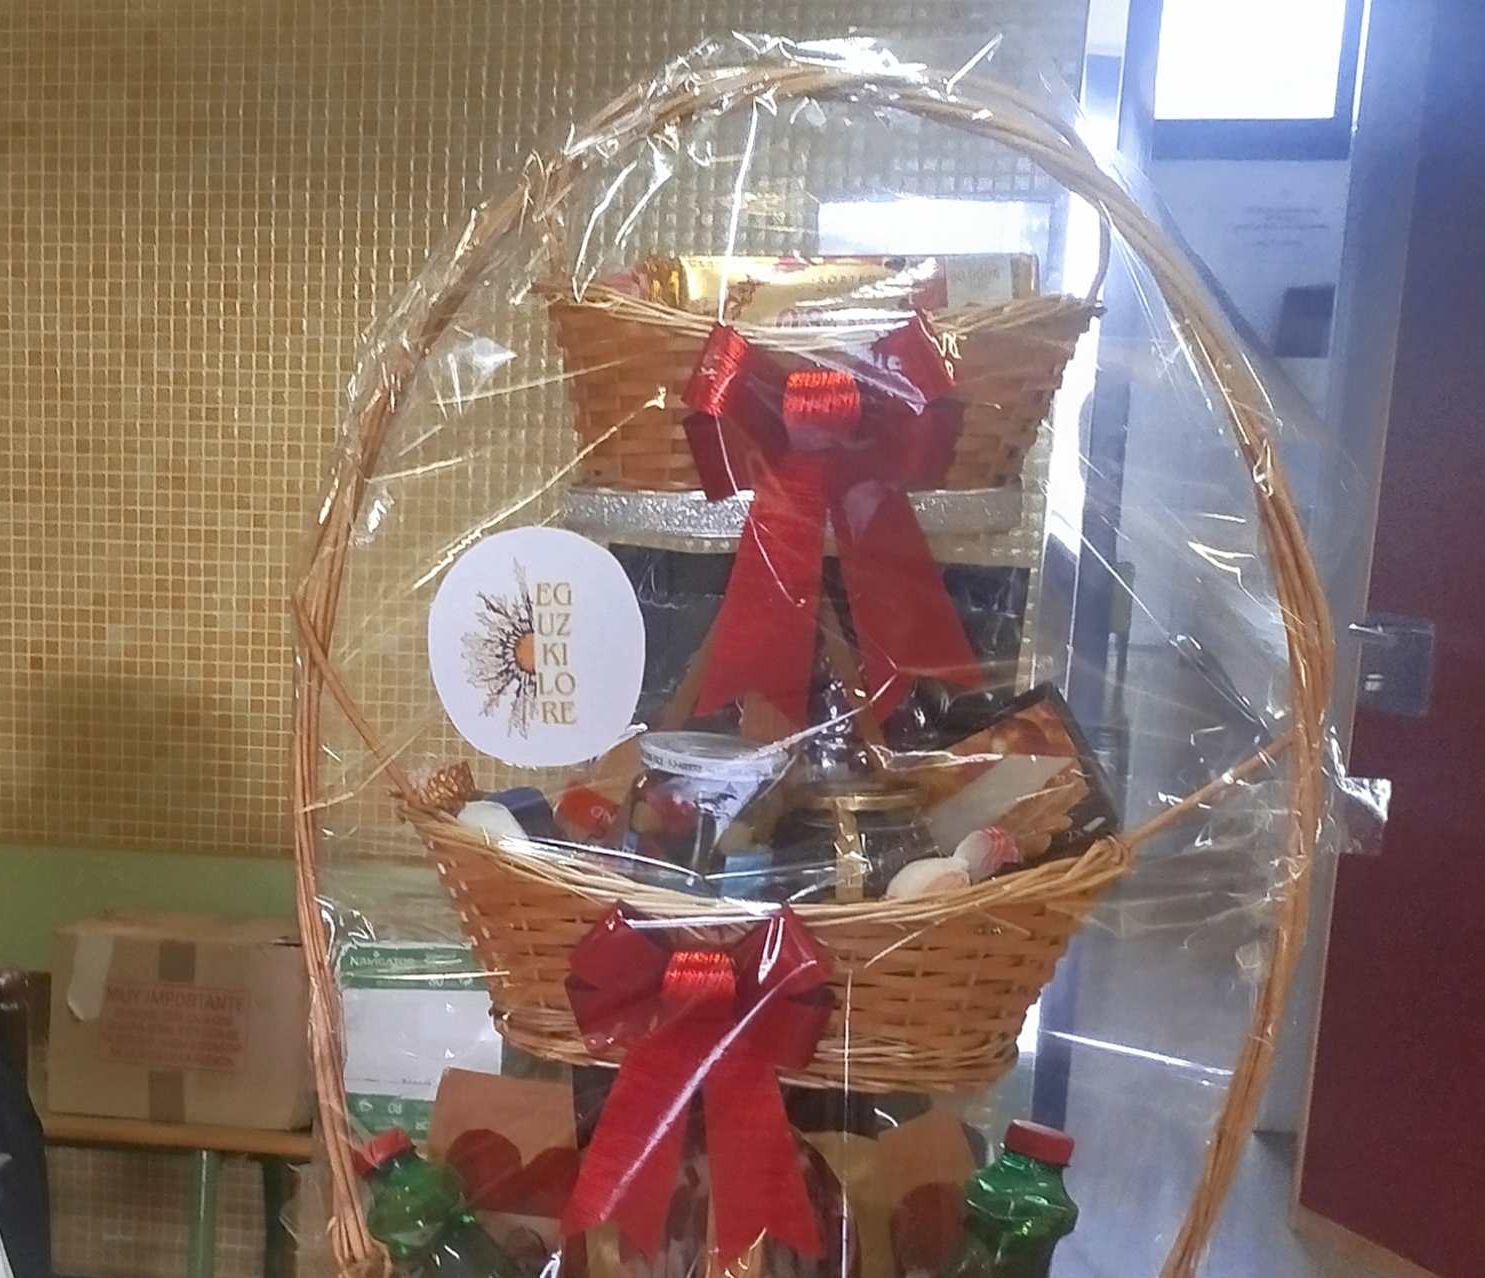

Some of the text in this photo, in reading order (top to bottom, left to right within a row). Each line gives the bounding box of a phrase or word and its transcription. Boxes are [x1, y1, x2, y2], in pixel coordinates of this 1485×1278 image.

[536, 582, 572, 607] EG
[537, 612, 571, 637] UZ
[543, 642, 568, 666] KI
[538, 671, 576, 696] LO
[542, 701, 577, 724] RE
[147, 990, 245, 1012] IMPORTANTE
